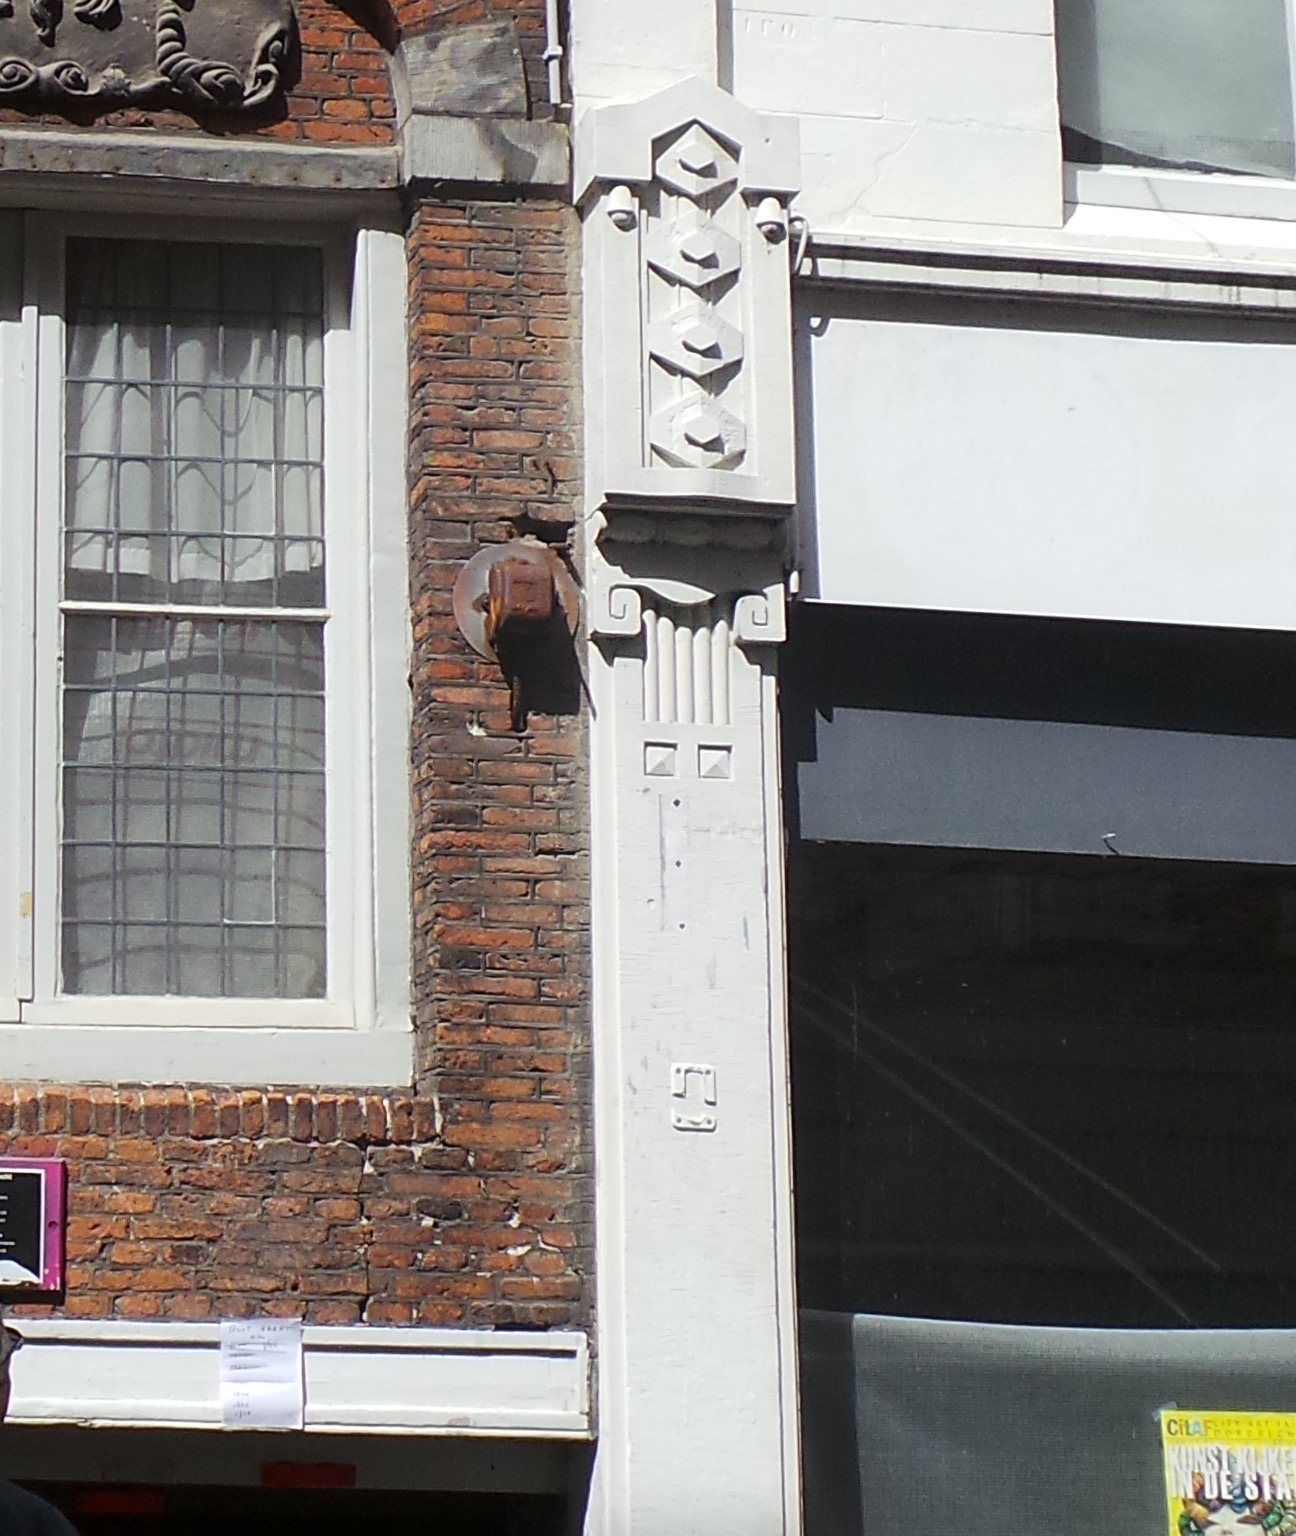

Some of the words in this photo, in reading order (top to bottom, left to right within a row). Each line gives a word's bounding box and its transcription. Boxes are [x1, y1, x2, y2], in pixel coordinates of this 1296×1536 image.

[1167, 1445, 1232, 1473] KUNST
[1236, 1446, 1296, 1474] KIJKE
[1204, 1472, 1233, 1500] DE
[1244, 1473, 1296, 1500] STA
